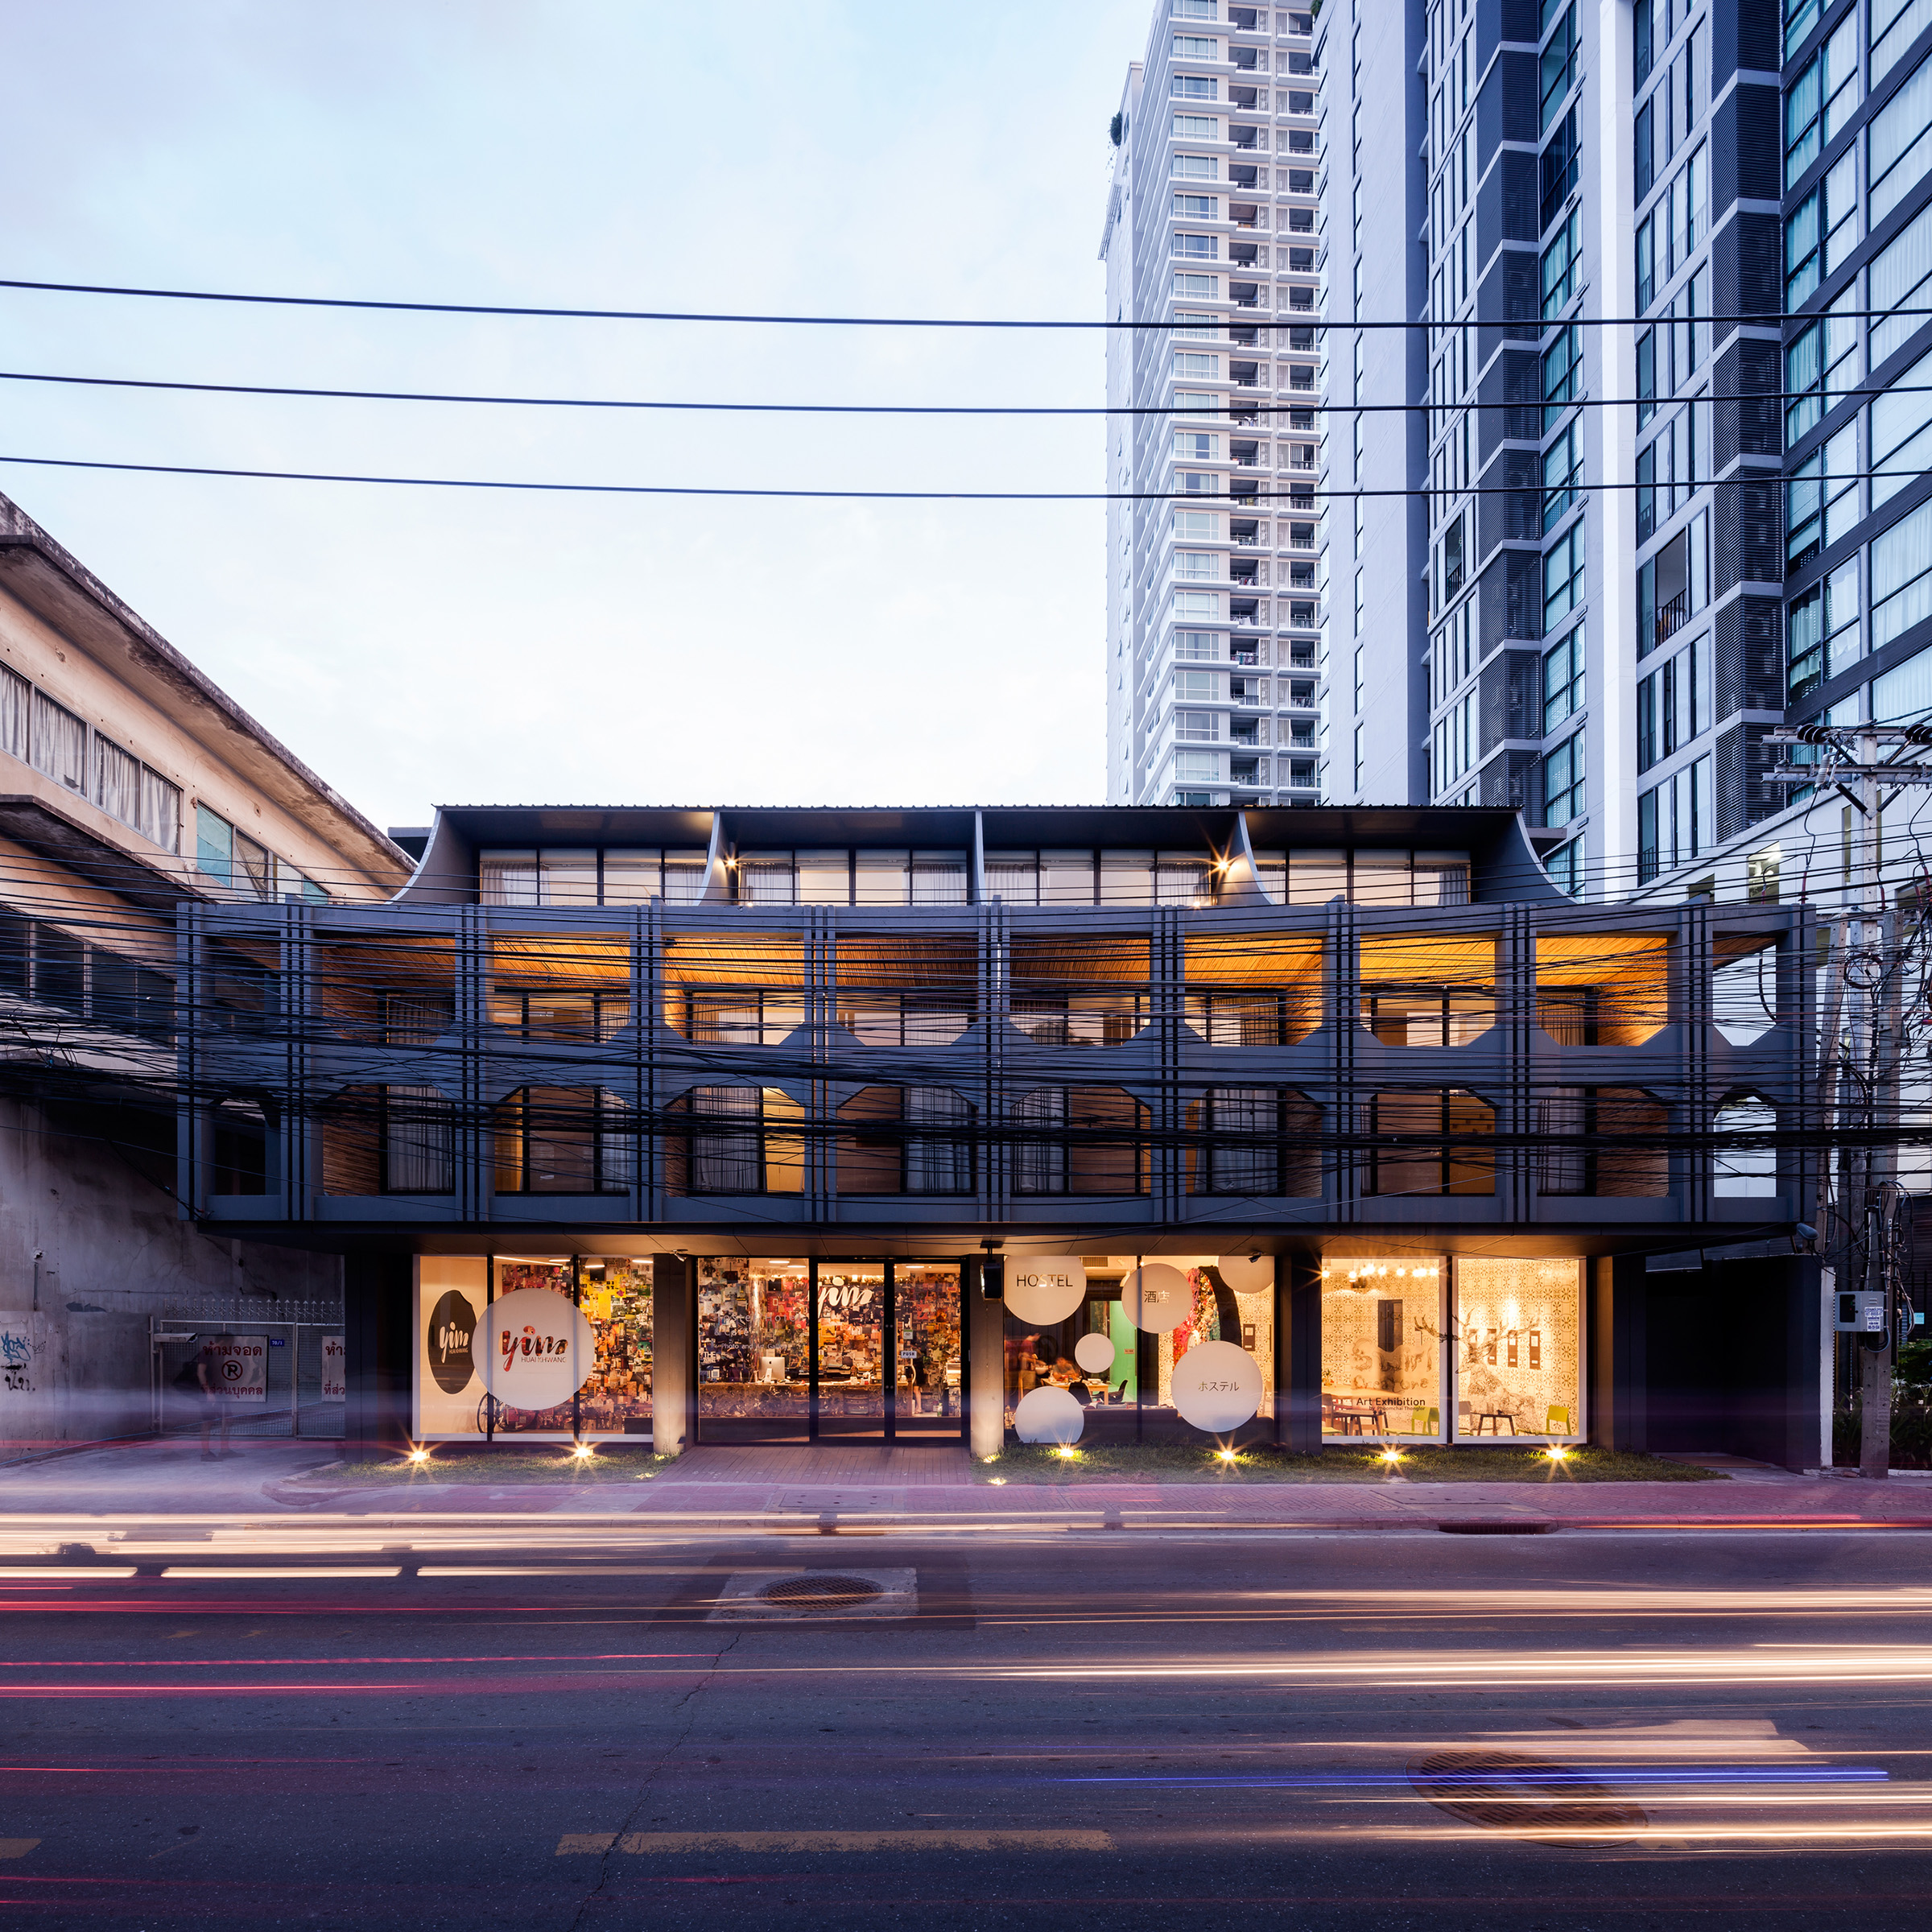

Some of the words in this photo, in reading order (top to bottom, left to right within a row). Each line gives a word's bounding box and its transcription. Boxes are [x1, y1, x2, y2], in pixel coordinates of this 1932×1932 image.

[1016, 1274, 1073, 1287] HOSTEL
[1144, 1290, 1170, 1303] 酒店
[202, 1340, 262, 1356] ห้ามจอด
[325, 1340, 345, 1356] ห้า
[439, 1321, 469, 1364] yim
[497, 1325, 568, 1372] yim
[1198, 1381, 1241, 1393] ホステル
[1356, 1397, 1373, 1406] Art
[1375, 1397, 1426, 1406] Exhibition
